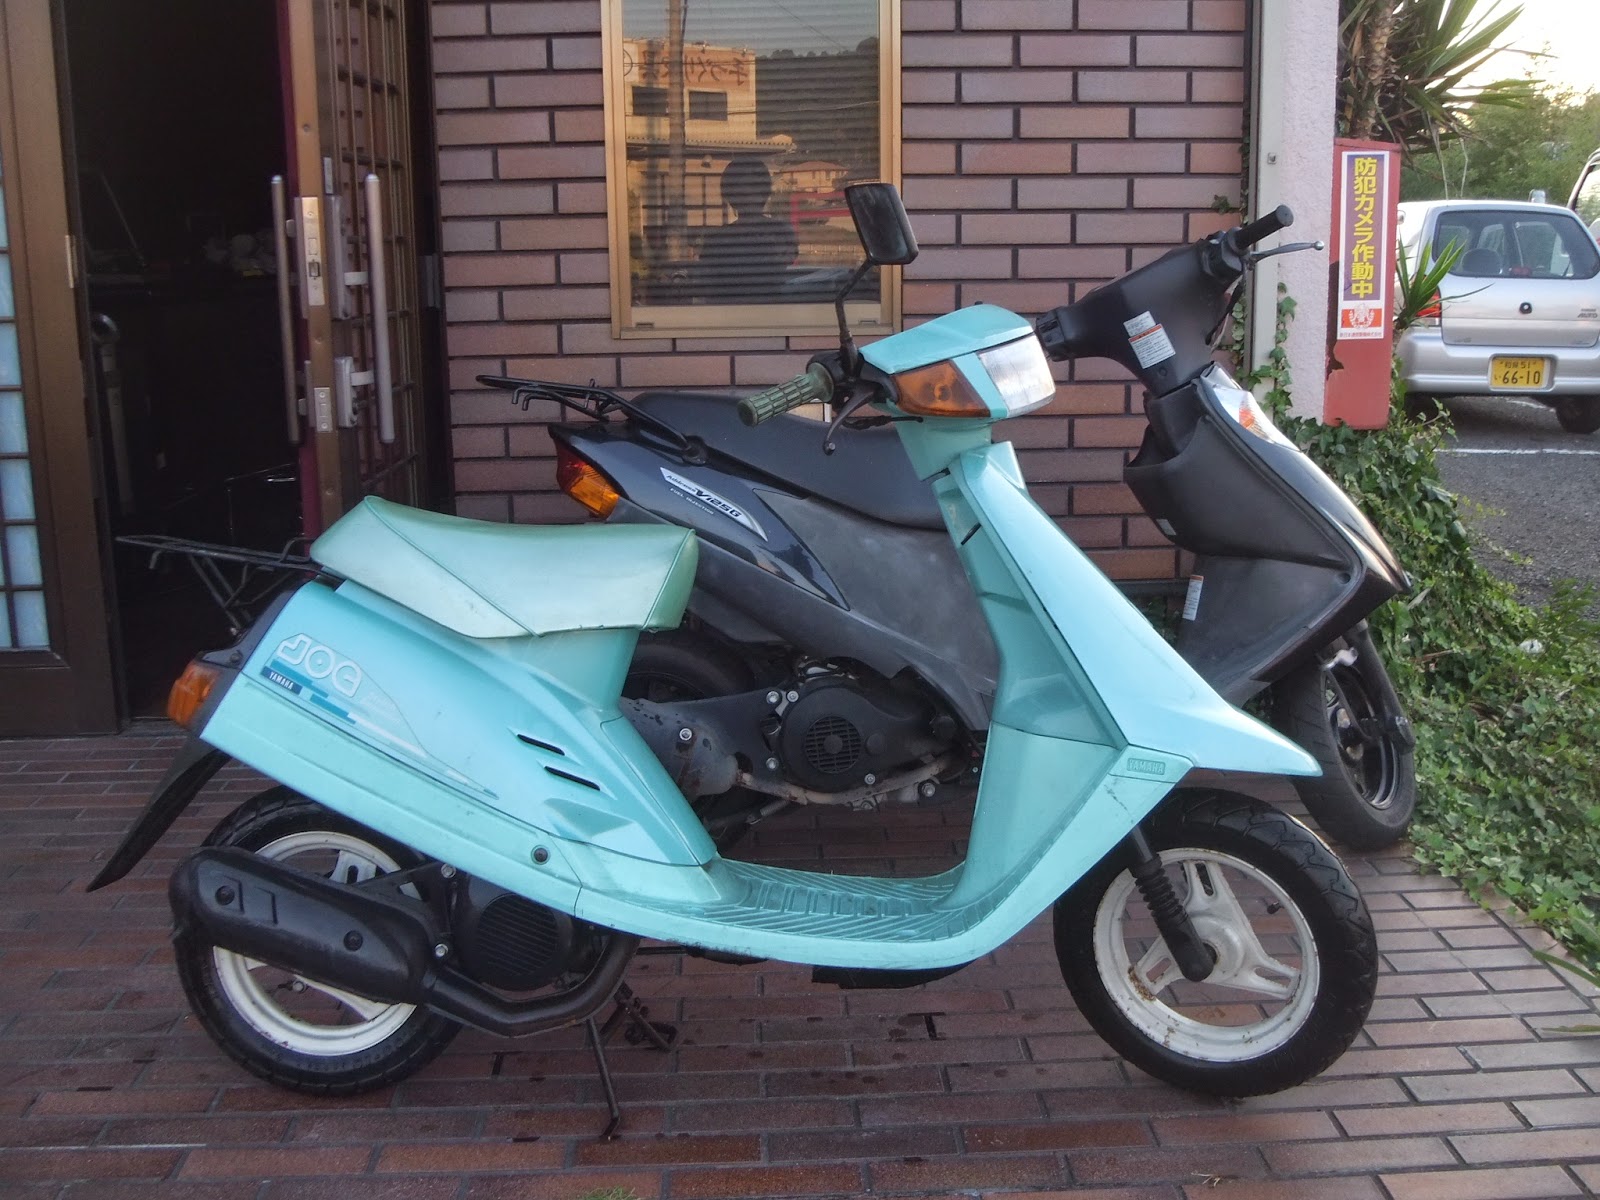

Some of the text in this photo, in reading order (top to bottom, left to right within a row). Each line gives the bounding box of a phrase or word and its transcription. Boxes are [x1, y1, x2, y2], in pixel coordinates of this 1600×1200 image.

[1351, 157, 1377, 299] 防犯カメラ作動中
[1502, 370, 1541, 385] 66-10
[669, 487, 685, 498] FUEL
[276, 633, 362, 698] JOG
[268, 671, 295, 691] YAMAHA
[1128, 759, 1164, 775] YAMAHA
